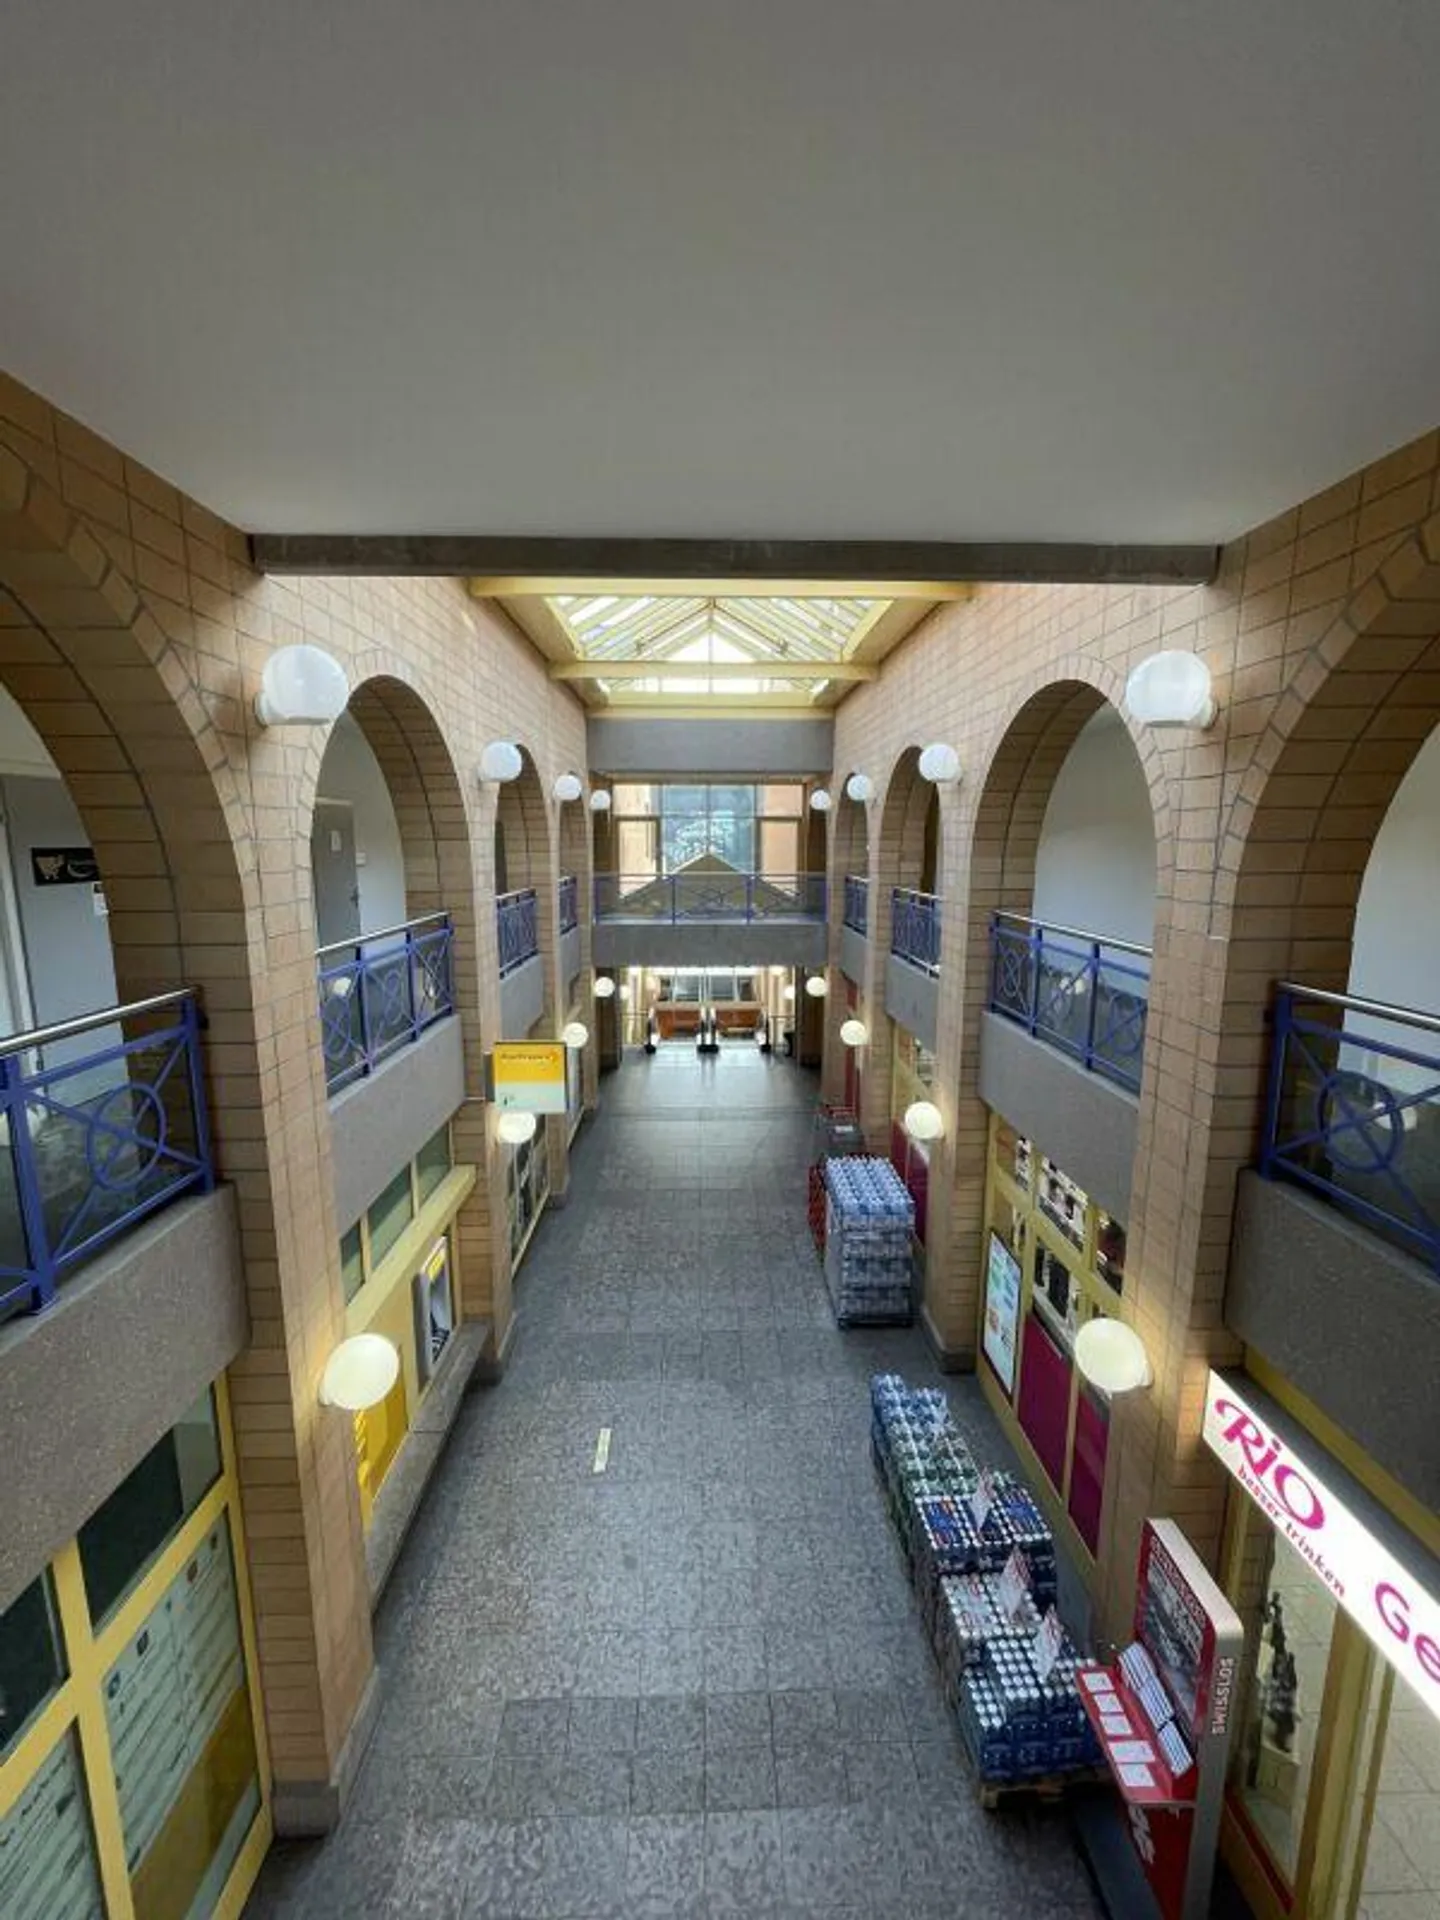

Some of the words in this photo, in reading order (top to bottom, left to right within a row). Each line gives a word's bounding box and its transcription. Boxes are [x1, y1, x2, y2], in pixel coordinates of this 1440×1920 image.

[1237, 1463, 1281, 1518] besser
[1285, 1521, 1346, 1597] trinken
[1211, 1658, 1234, 1734] SWISSLOS
